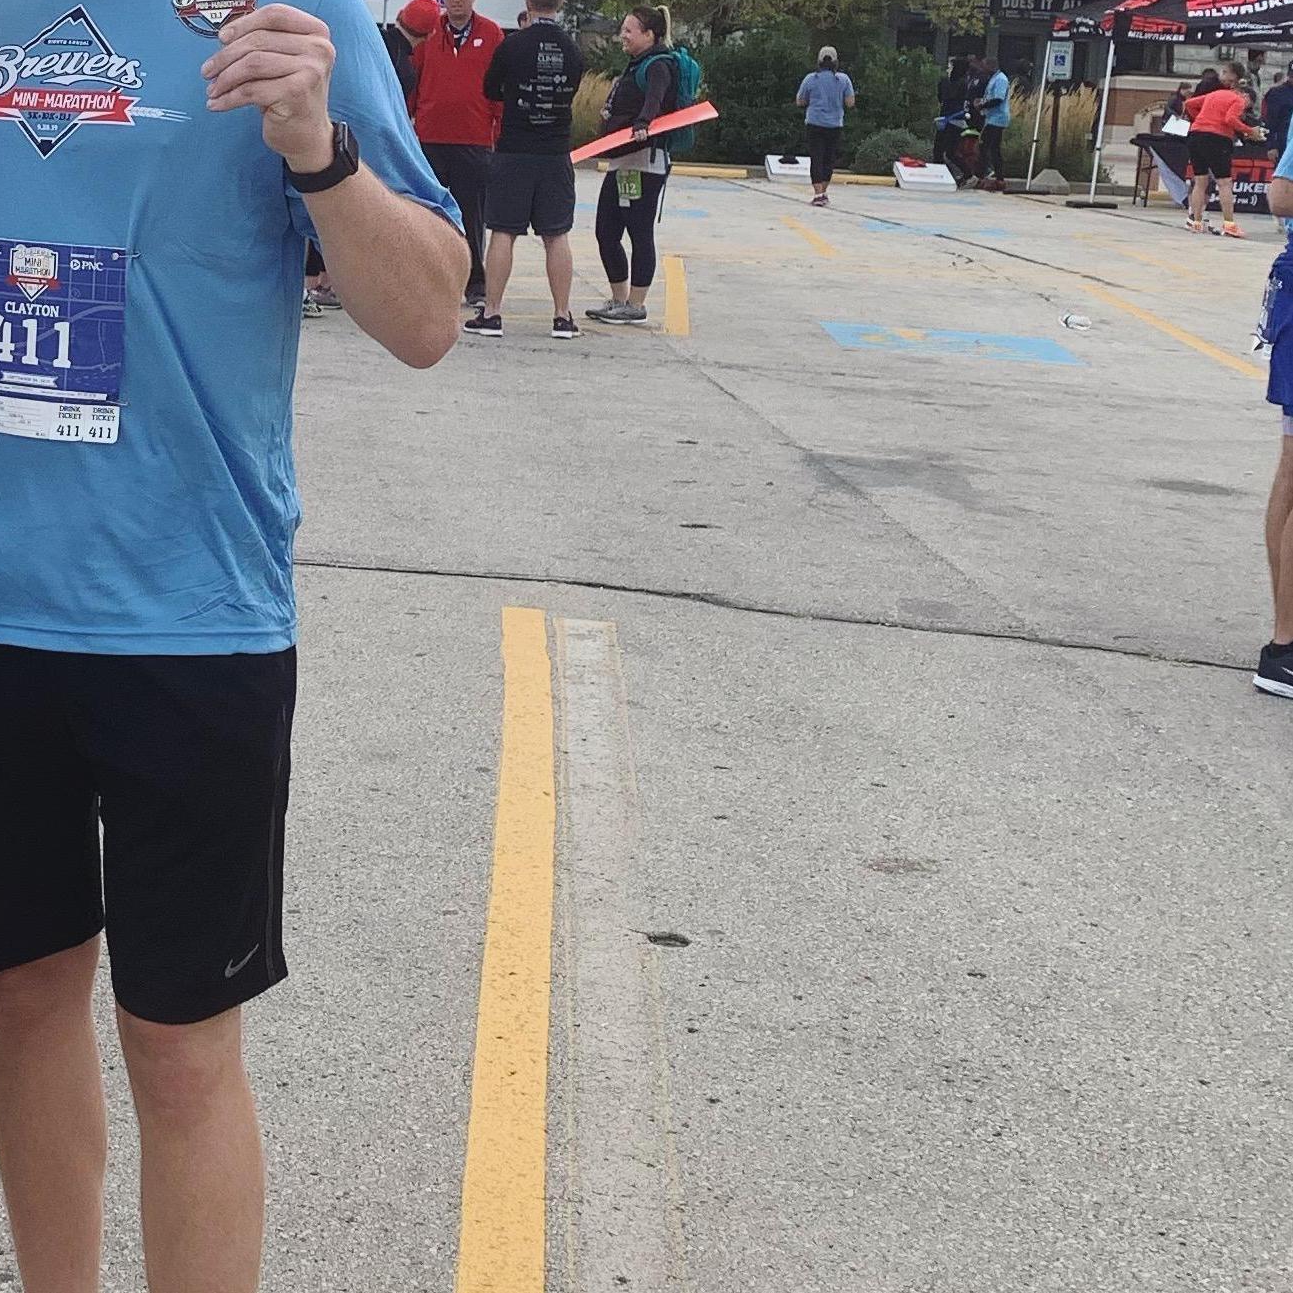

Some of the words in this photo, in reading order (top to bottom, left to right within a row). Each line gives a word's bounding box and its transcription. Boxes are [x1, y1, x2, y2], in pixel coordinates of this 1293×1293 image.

[12, 91, 116, 110] MINI-MARATHON
[24, 257, 43, 267] MINI
[81, 260, 104, 271] PNC
[4, 300, 60, 318] CLAYTON
[58, 412, 82, 420] TICKET
[92, 414, 116, 422] TICKET
[57, 424, 80, 437] 411
[89, 426, 112, 439] 411
